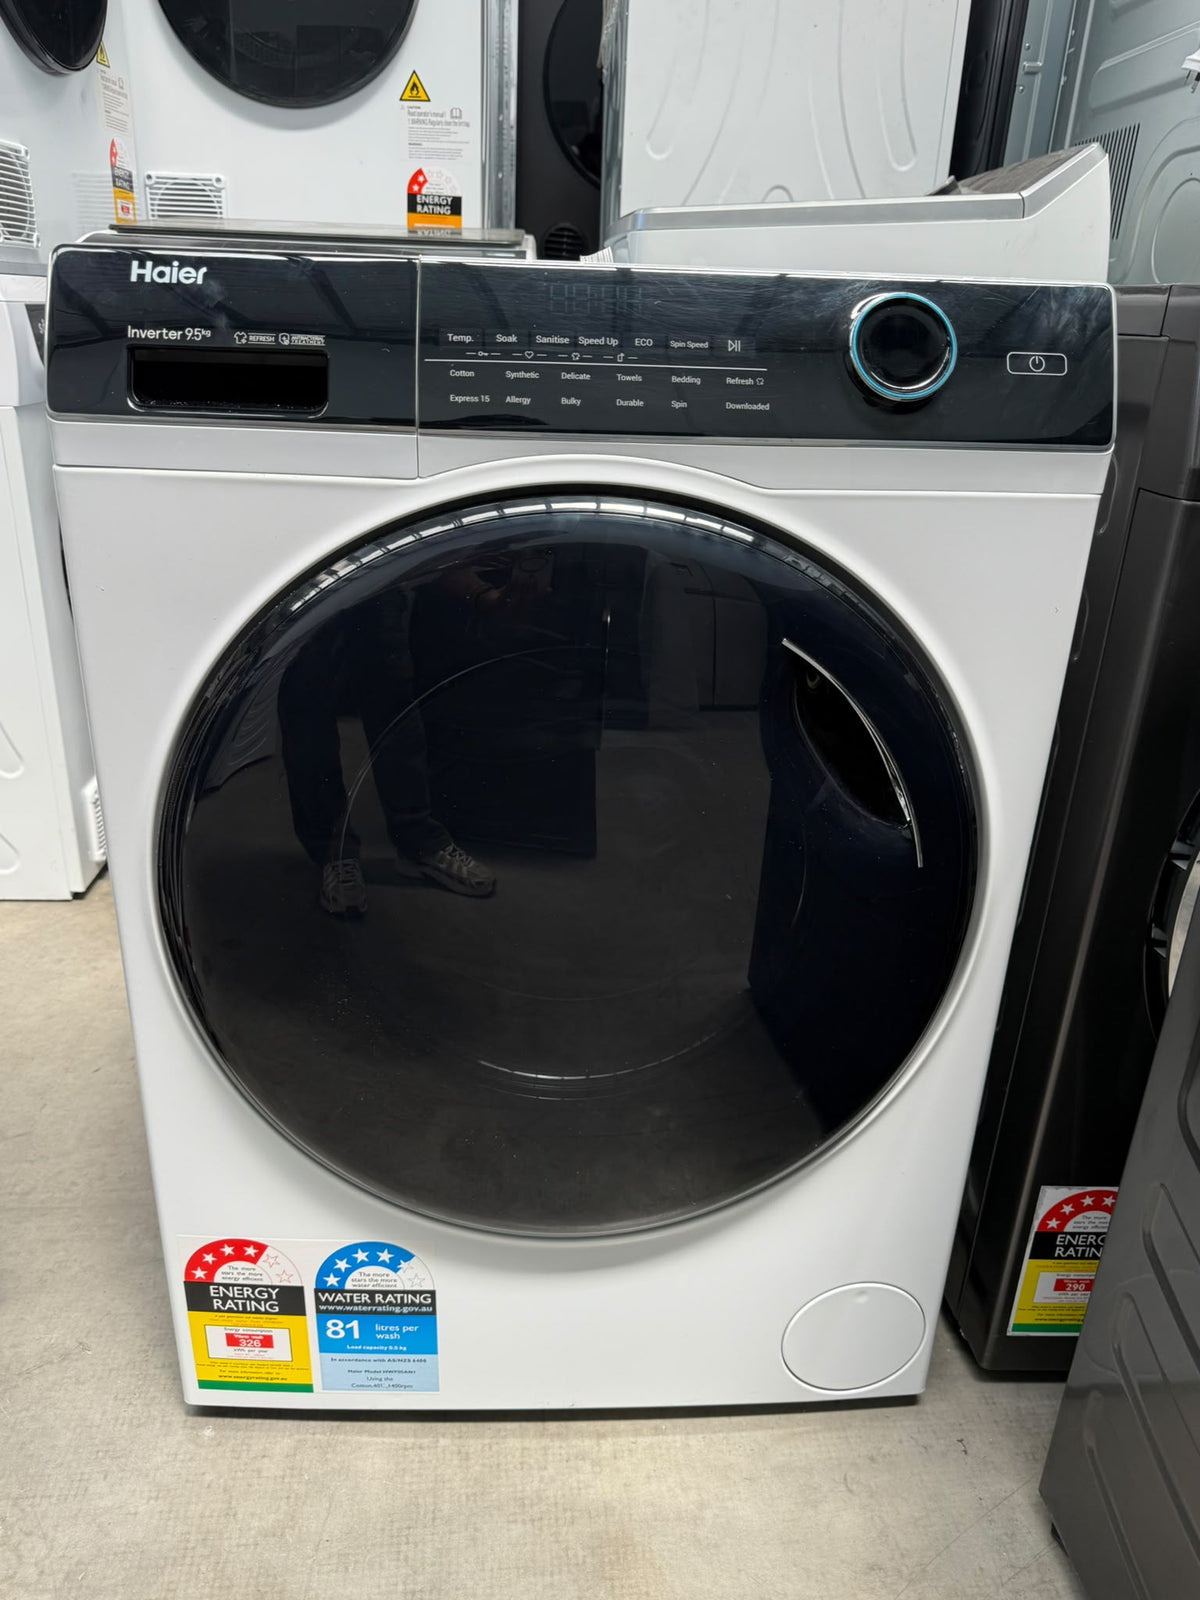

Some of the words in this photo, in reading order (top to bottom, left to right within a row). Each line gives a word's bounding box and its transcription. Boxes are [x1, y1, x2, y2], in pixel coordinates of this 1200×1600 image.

[416, 195, 452, 205] ENERGY
[416, 204, 451, 215] RATING
[130, 260, 207, 284] Haier
[127, 325, 183, 340] Inverter
[448, 333, 474, 343] Temp.
[496, 334, 518, 343] Soak
[536, 335, 570, 344] Sanitise
[578, 336, 605, 346] Speed
[606, 337, 618, 347] Up
[635, 338, 653, 346] ECO
[670, 340, 686, 349] Spin
[687, 341, 708, 349] Speed
[505, 370, 540, 380] Synthetic
[561, 372, 591, 380] Delicate
[672, 376, 701, 385] Bedding
[450, 394, 479, 403] Express
[505, 396, 531, 405] Allergy
[561, 397, 581, 406] Bulky
[726, 402, 770, 410] Downloaded
[1054, 1246, 1103, 1258] RATIN
[209, 1286, 280, 1299] ENERGY
[319, 1292, 371, 1304] WATER
[375, 1293, 431, 1304] RATING
[213, 1300, 279, 1312] RATING
[319, 1304, 432, 1313] www.waterrating.gov.au
[326, 1319, 360, 1339] 81
[239, 1339, 261, 1347] 326
